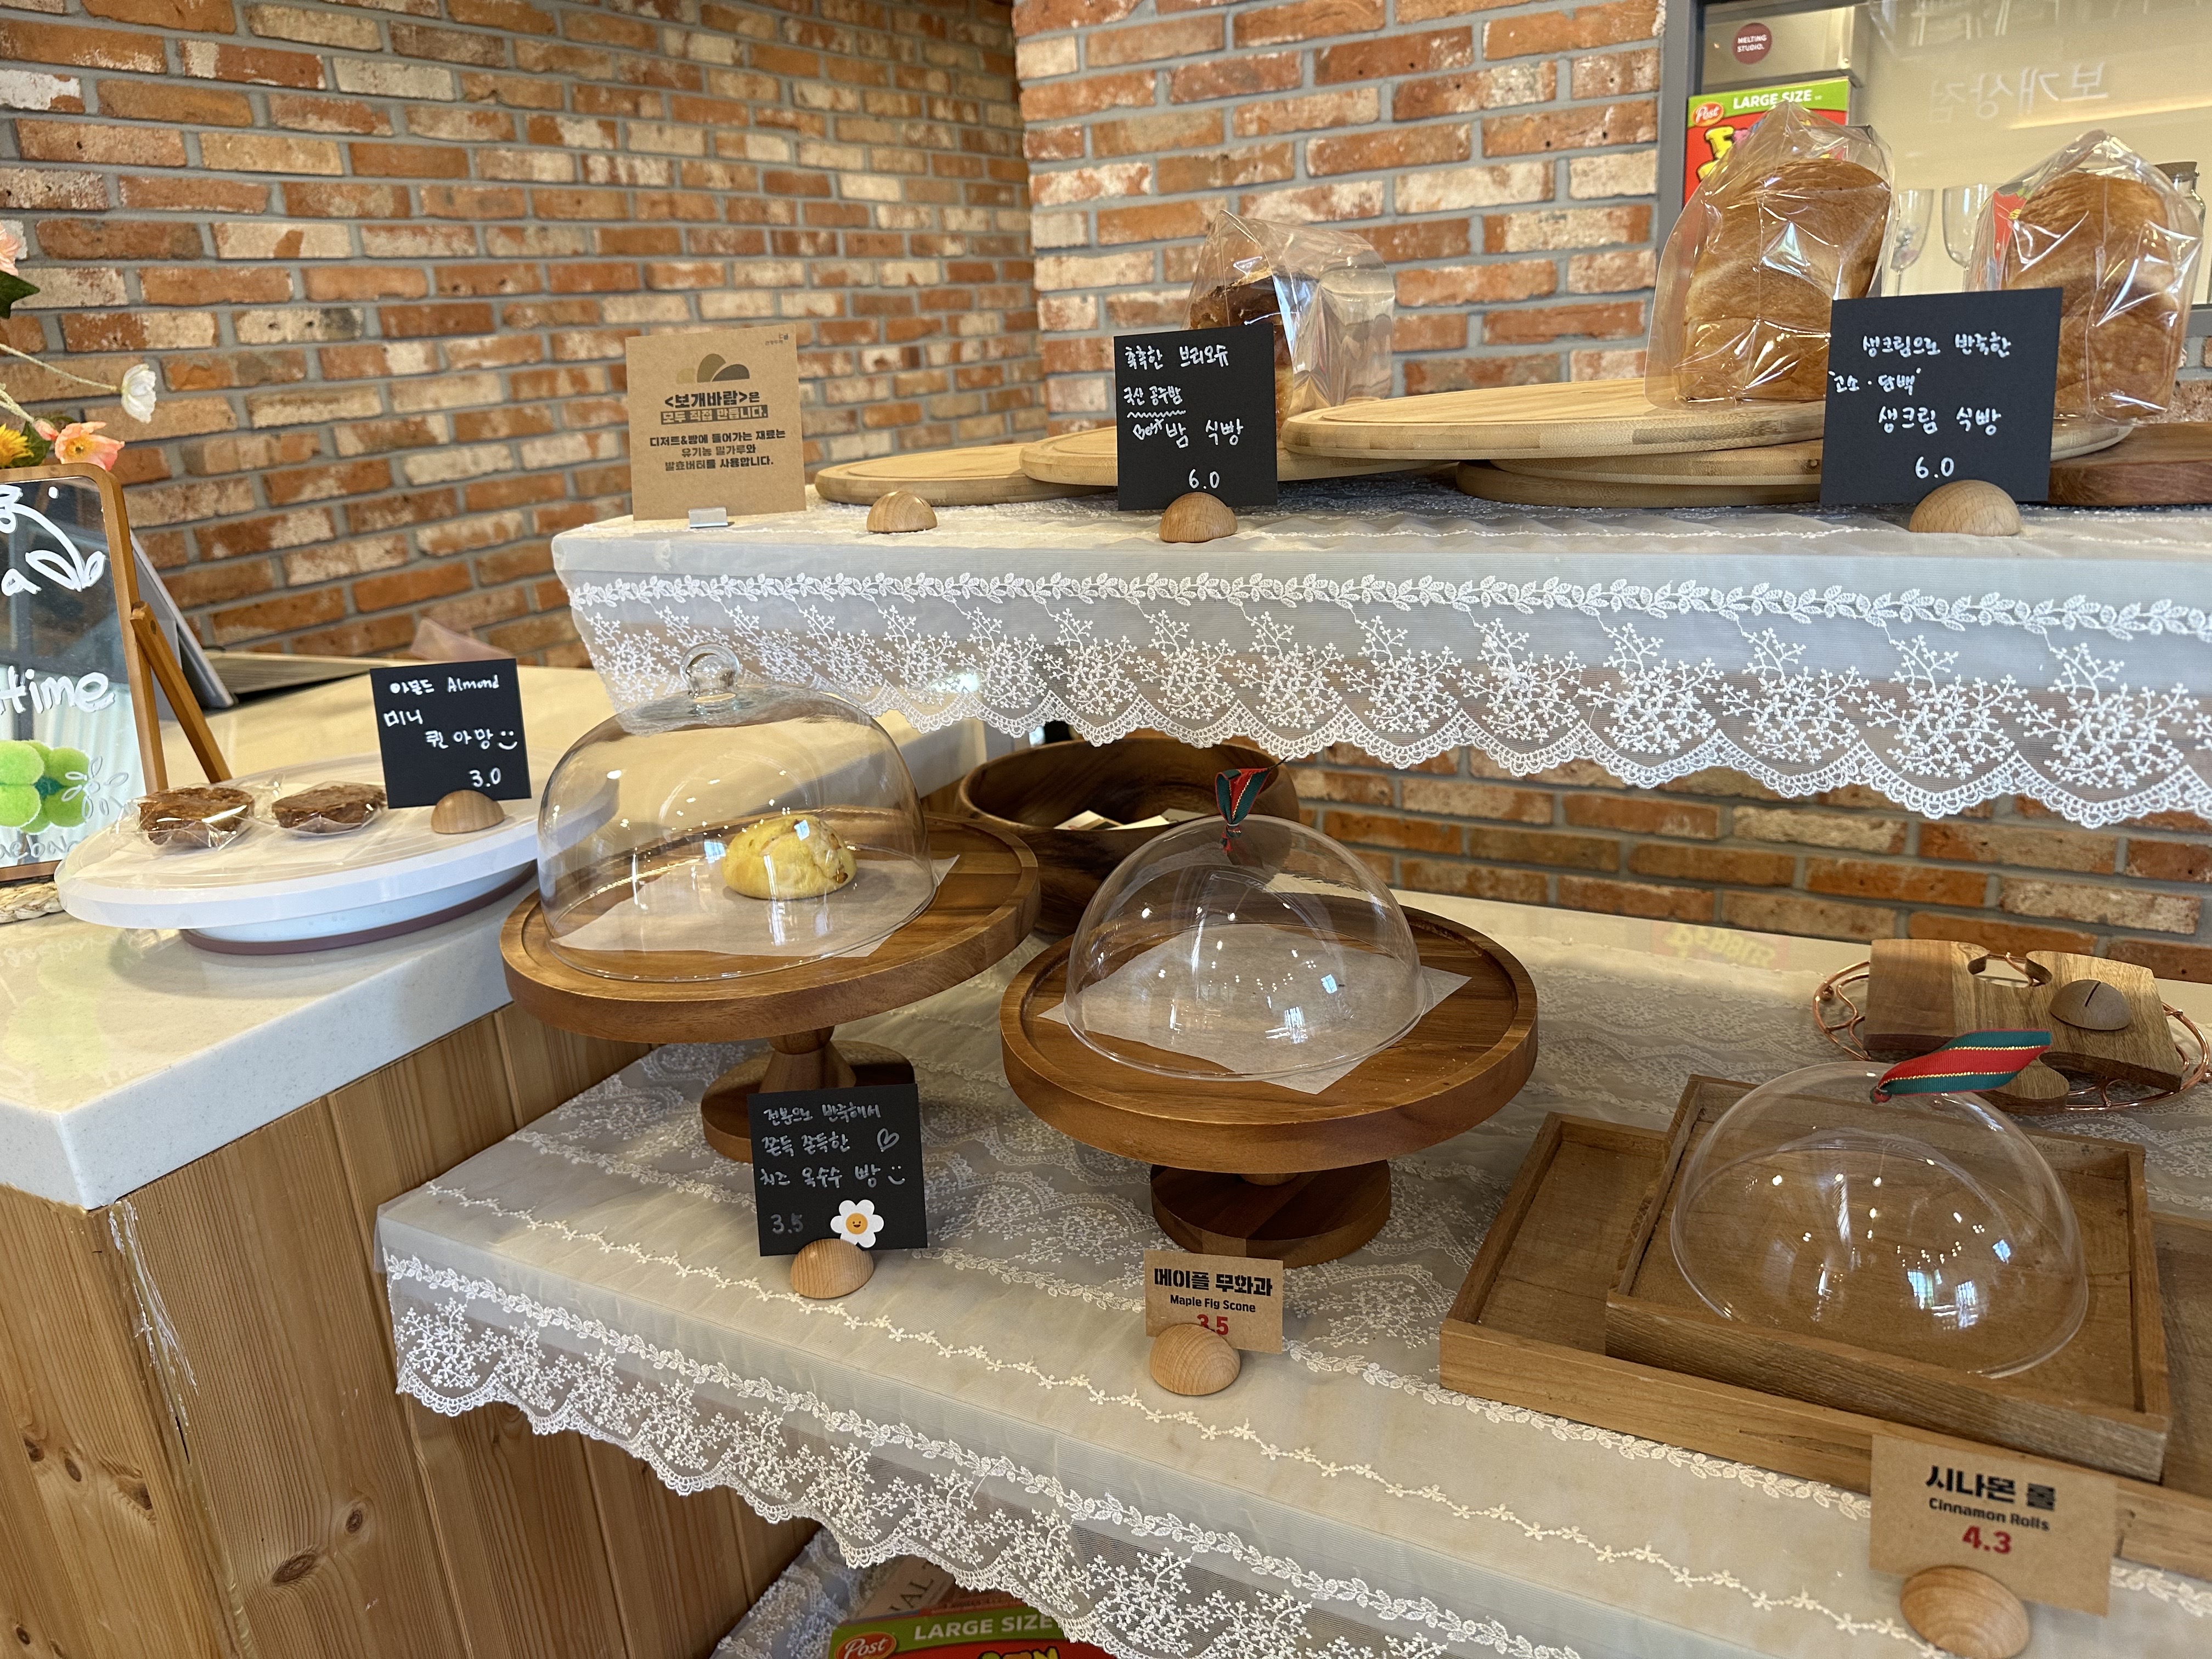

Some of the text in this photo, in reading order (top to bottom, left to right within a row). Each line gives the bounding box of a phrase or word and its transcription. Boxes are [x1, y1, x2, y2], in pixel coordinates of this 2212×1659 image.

[1737, 34, 1767, 44] MELTING
[1733, 89, 1813, 109] LARGE SIZE
[1695, 103, 1719, 124] Post
[1863, 331, 2012, 358] 생크림으로 반죽한
[1124, 386, 1183, 405] 국산 공주밤
[663, 406, 767, 423] 모두 직접 만듭니다.
[1878, 406, 2001, 436] 생크림 식빵
[650, 429, 786, 447] 디저트&빵에 들어가는 재료는
[1205, 418, 1244, 445] 식빵
[681, 444, 756, 458] 유기농 밀가루와
[665, 456, 774, 472] 발효버터를 사용합니다.
[1915, 456, 1954, 479] 6.0
[1189, 469, 1220, 489] 6.0
[0, 665, 115, 715] time
[390, 674, 499, 695] 아몬드 Almond
[383, 709, 423, 727] 미니
[469, 768, 501, 787] 3.0
[760, 1164, 881, 1188] 치즈 옥수수 빵
[770, 1212, 804, 1234] 3.5
[1154, 1268, 1273, 1296] 메이플 무화과
[1170, 1294, 1256, 1312] Maple Fig Scone
[1925, 1465, 2016, 1504] 시나몬
[1929, 1497, 2050, 1531] Cinnamon Rolls
[1961, 1525, 2012, 1555] 4.3
[914, 1613, 1053, 1641] LARGE SIZE
[844, 1637, 889, 1659] Post
